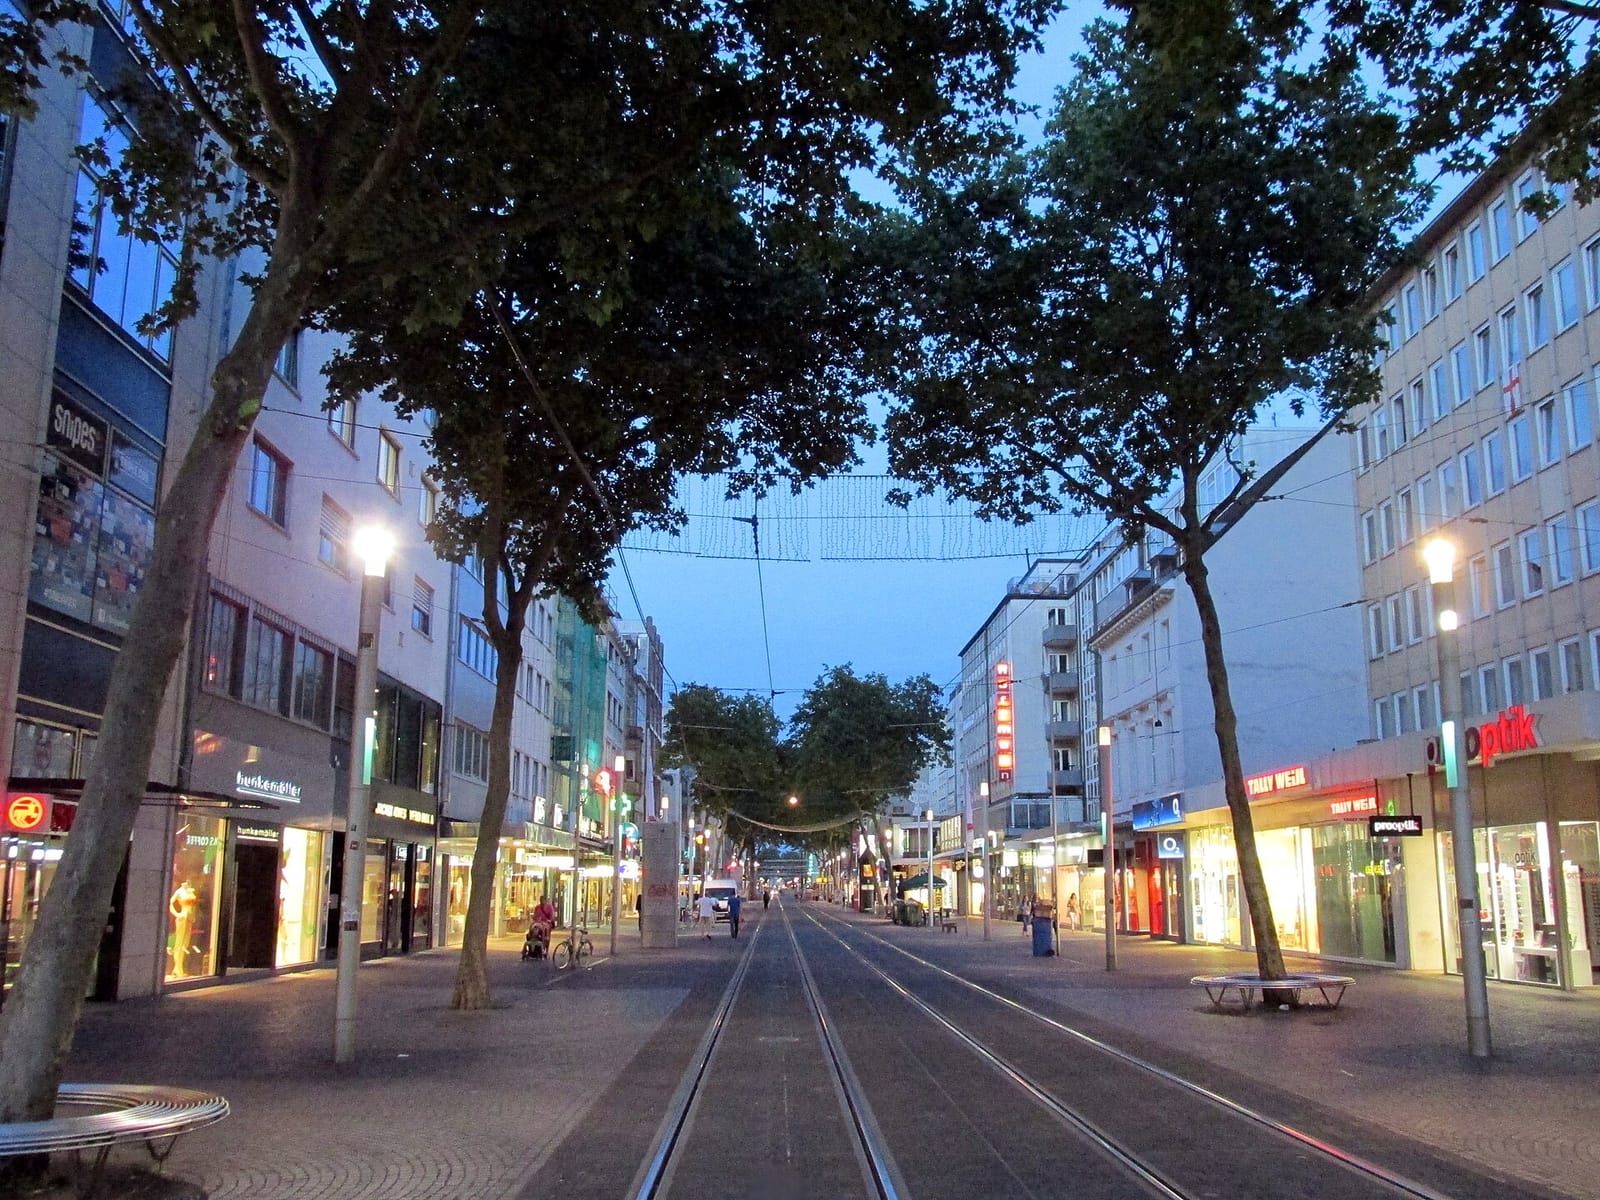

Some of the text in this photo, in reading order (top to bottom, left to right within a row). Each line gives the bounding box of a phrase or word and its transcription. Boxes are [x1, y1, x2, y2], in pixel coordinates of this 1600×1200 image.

[54, 404, 97, 453] snipes
[236, 770, 302, 797] hunkemöller
[1247, 773, 1273, 795] TALLY
[1331, 801, 1351, 815] TALLY
